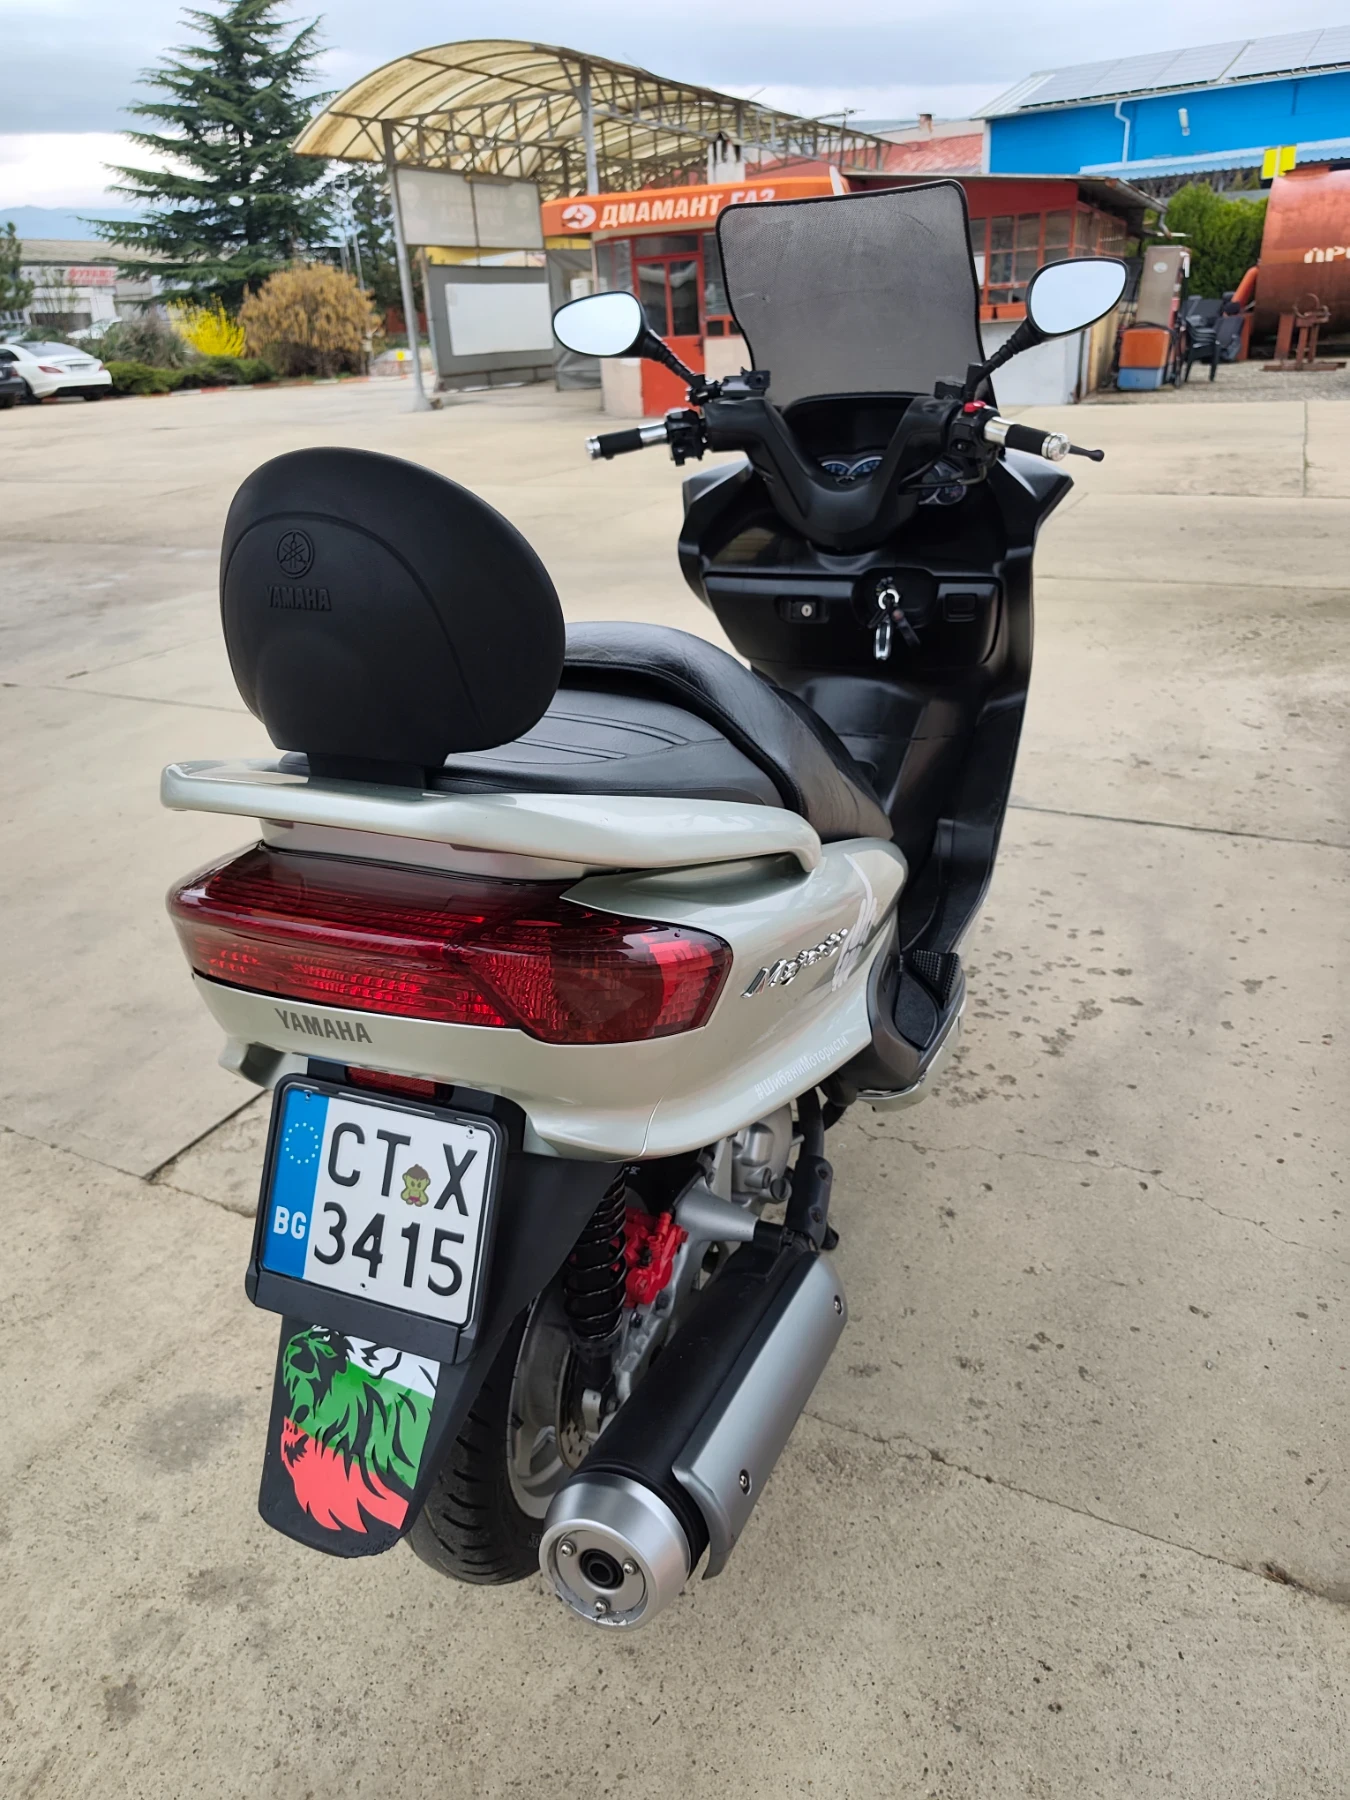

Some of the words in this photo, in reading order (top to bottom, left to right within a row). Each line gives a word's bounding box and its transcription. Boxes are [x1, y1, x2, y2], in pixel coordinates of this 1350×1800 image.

[599, 195, 723, 229] ДИАМАНТ
[1303, 245, 1350, 264] ПР
[266, 585, 332, 611] YAMAHA
[274, 1007, 373, 1044] YAMAHA
[273, 1205, 307, 1240] BG
[314, 1201, 465, 1297] 3415
